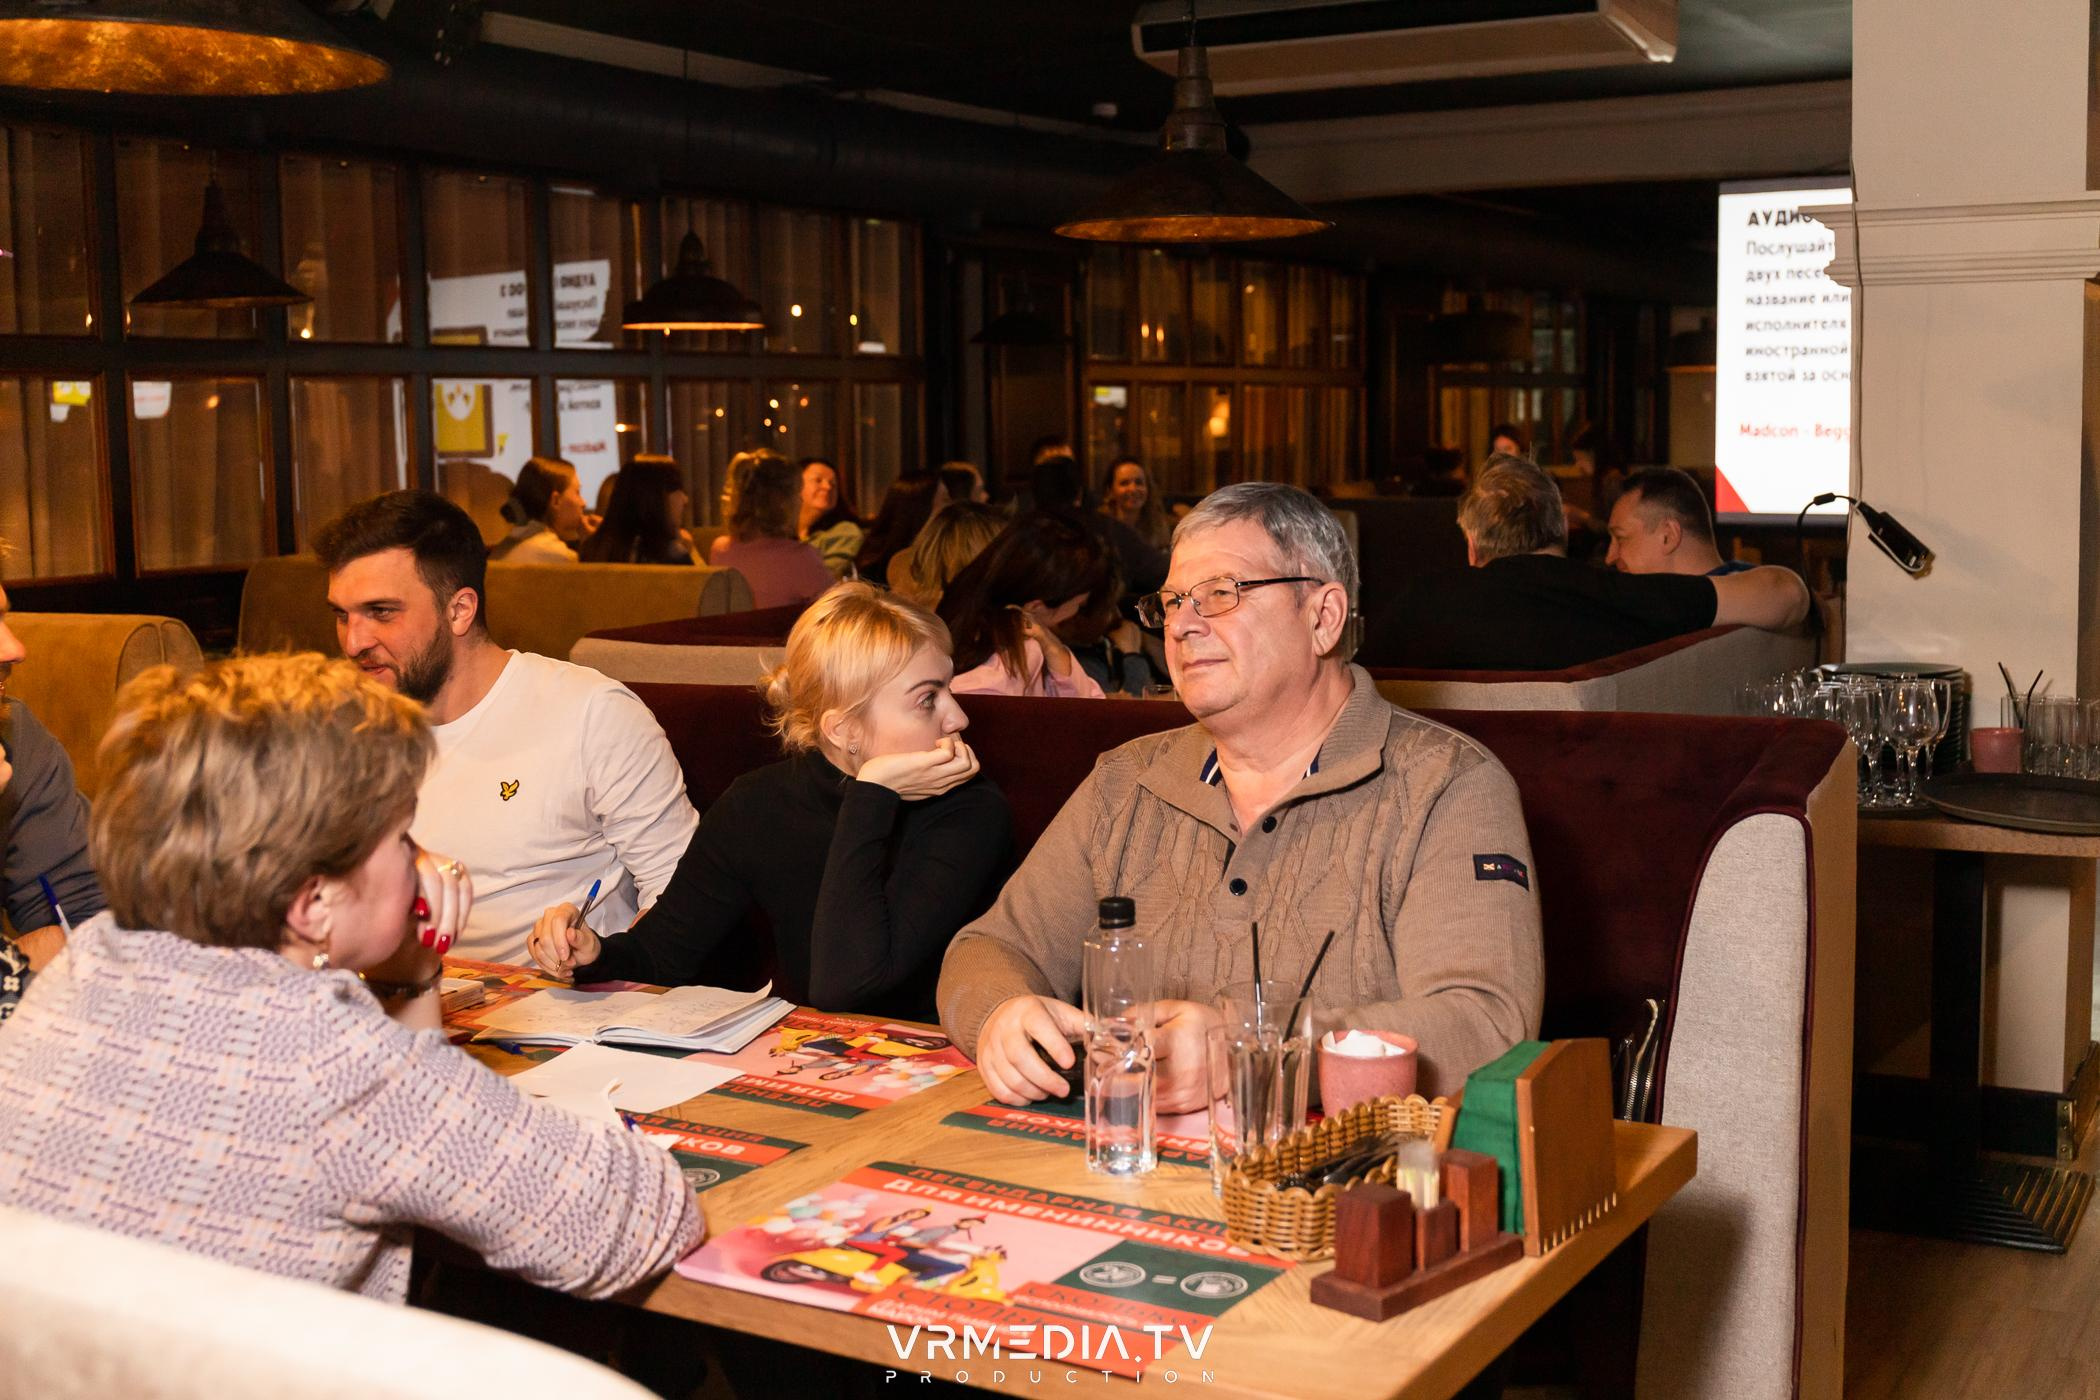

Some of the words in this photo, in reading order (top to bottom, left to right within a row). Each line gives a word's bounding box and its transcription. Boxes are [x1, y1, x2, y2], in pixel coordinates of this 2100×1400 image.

[1739, 422, 1799, 438] Madcon
[884, 1178, 961, 1201] ДЛЯ
[907, 1168, 1143, 1220] ЛЕГЕНДАРНАЯ
